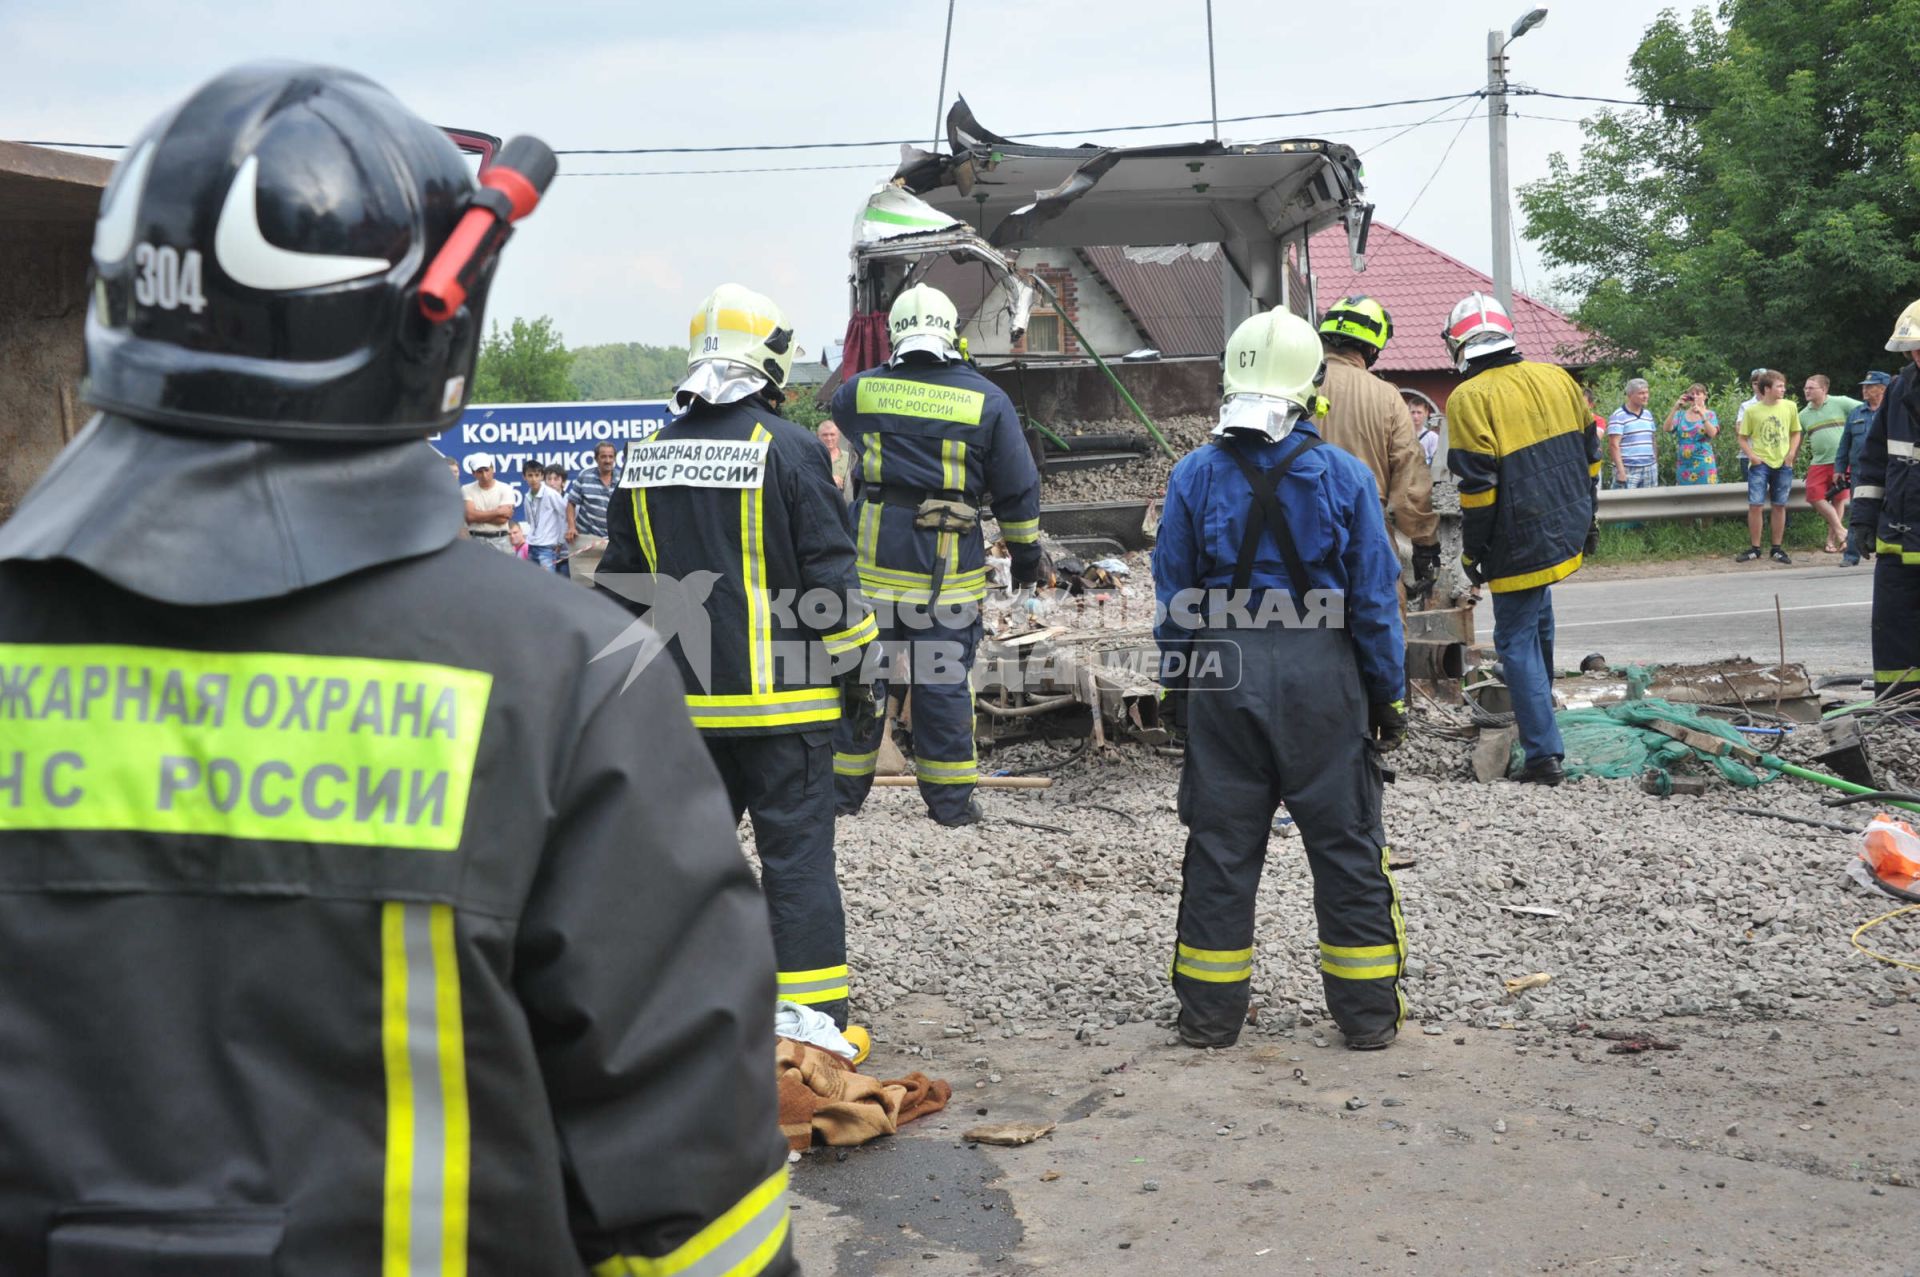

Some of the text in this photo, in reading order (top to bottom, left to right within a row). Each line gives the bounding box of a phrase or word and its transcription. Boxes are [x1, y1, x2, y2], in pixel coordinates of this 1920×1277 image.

[135, 241, 208, 314] 304
[895, 314, 951, 333] 204 204
[703, 336, 719, 353] 04
[864, 381, 973, 405] ПОЖАРНАЯ ОХРАНА
[877, 397, 954, 416] МЧС РОССИИ
[631, 445, 760, 463] ПОЖАРНАЯ ОХРАНА
[627, 464, 759, 483] МЧС РОССИИ
[243, 672, 457, 740] ОХРАНА
[156, 755, 448, 827] РОССИИ
